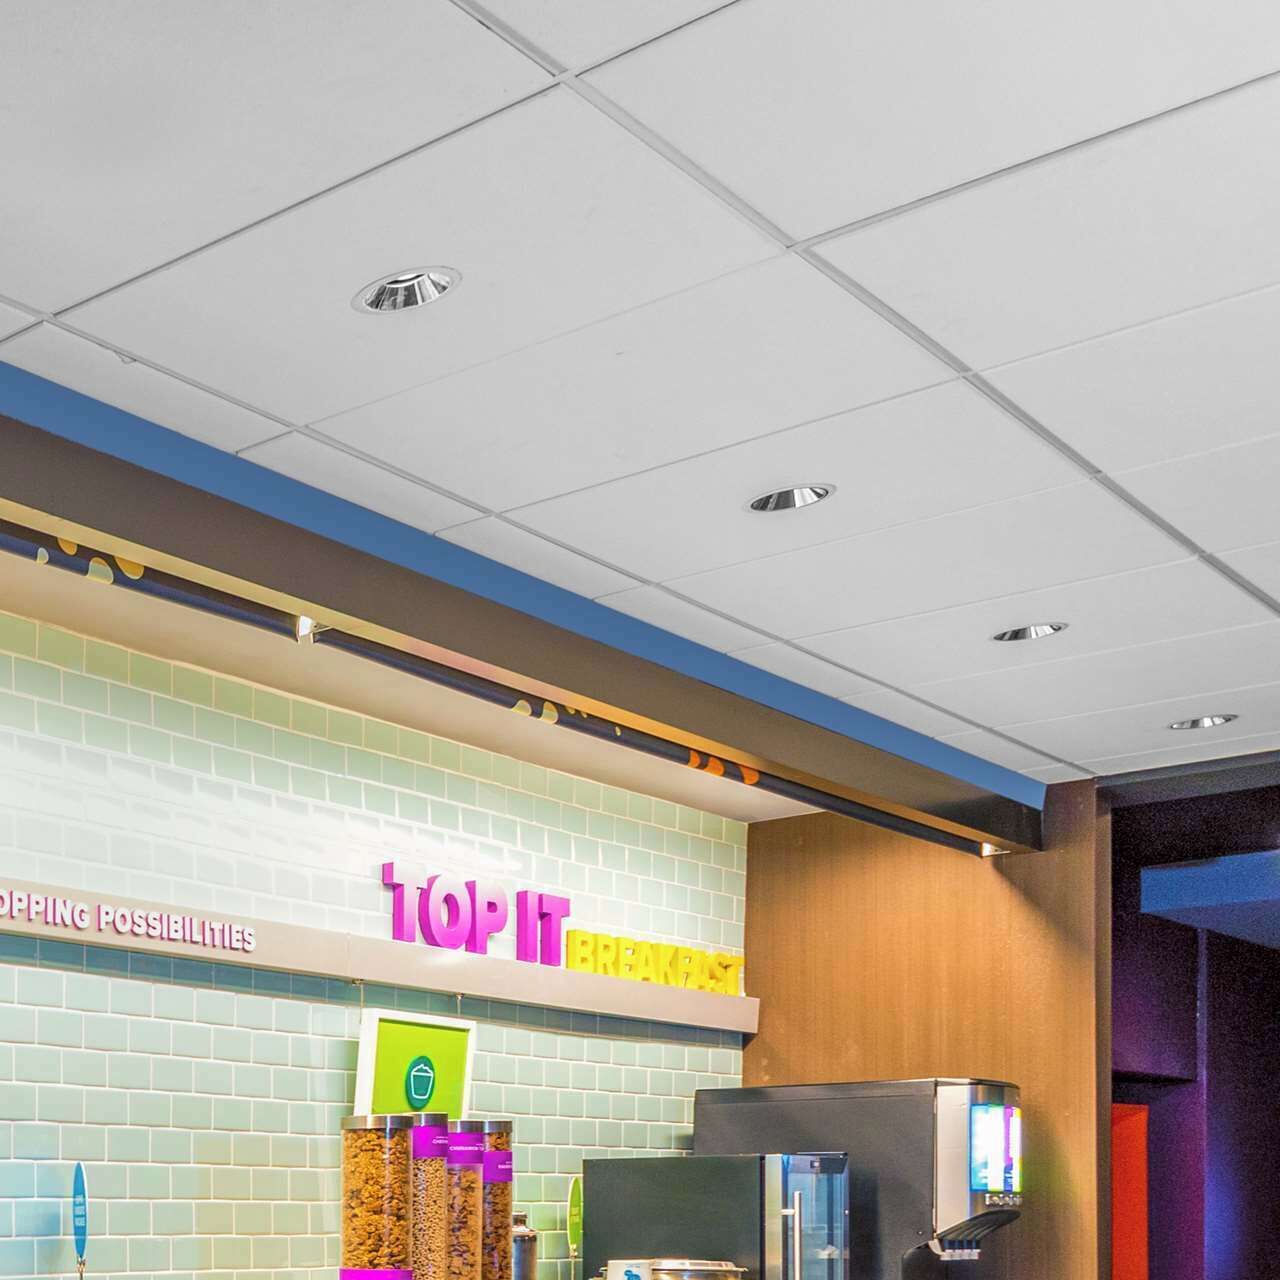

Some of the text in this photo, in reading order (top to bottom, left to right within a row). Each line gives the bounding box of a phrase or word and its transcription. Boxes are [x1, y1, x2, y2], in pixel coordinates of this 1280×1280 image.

[97, 904, 256, 952] POSSIBILITIES
[382, 862, 570, 966] TOP IT
[566, 929, 744, 996] BREAKFAST
